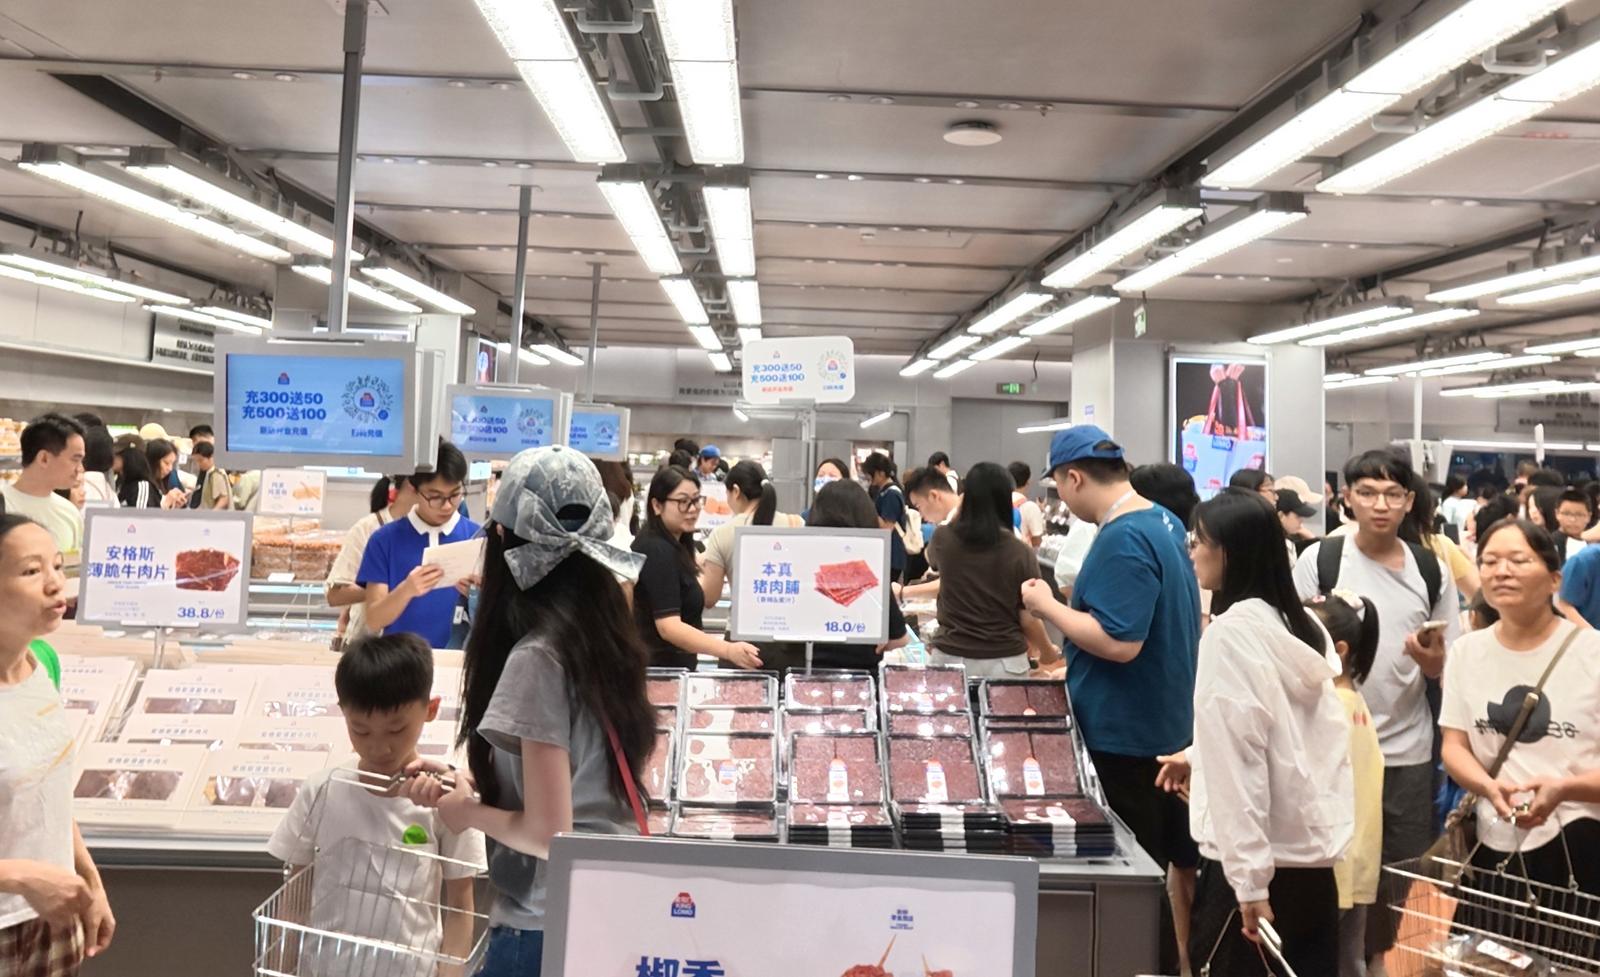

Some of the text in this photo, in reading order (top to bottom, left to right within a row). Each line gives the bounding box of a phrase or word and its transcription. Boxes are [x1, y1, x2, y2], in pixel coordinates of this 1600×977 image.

[245, 390, 324, 405] 充300送50
[242, 405, 327, 421] 充500送100
[106, 545, 155, 562] 安格斯
[88, 562, 169, 580] 薄脆牛肉片
[762, 562, 792, 577] 本真
[753, 579, 800, 595] 猪肉脯
[177, 607, 225, 619] 38.8/份
[825, 621, 866, 633] 18.0/份
